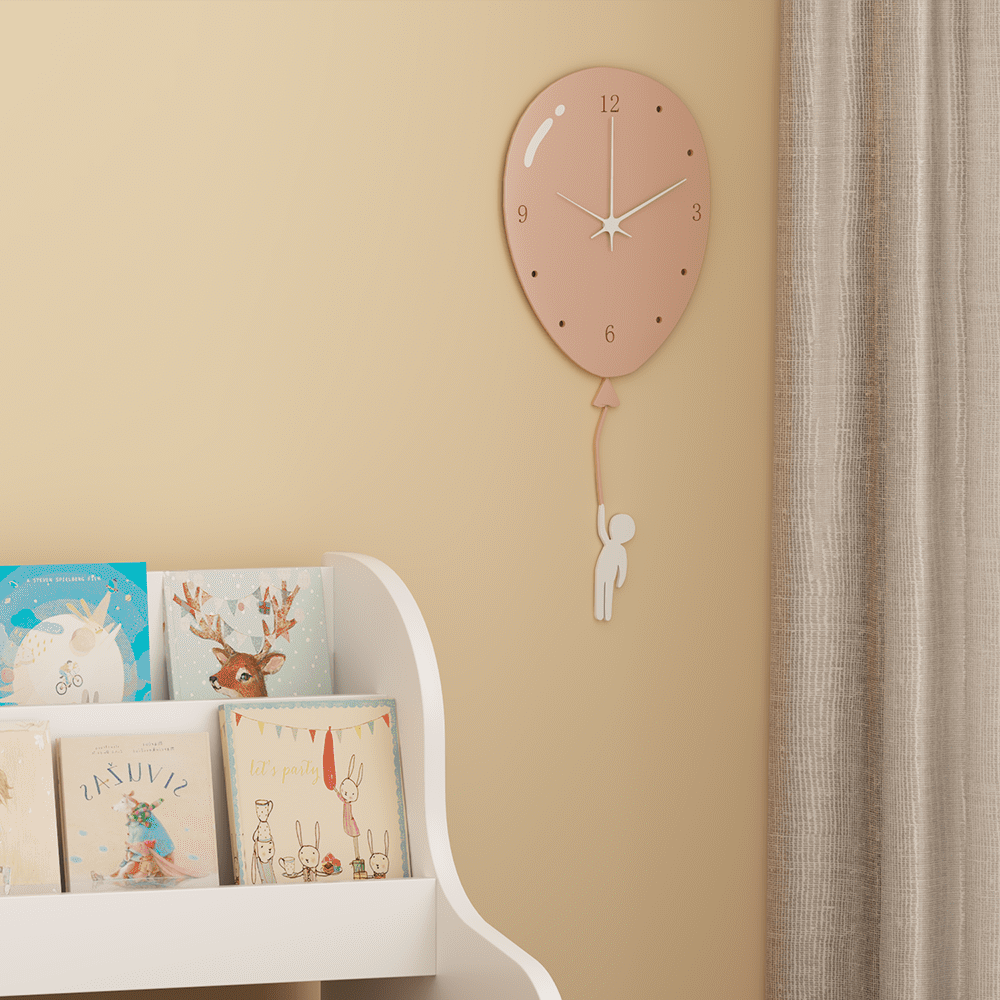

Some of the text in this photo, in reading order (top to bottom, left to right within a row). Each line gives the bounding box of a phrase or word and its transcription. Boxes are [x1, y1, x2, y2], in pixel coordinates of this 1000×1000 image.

[600, 94, 620, 113] 12
[517, 204, 528, 223] 9
[692, 203, 702, 222] 3
[604, 324, 615, 343] 6
[250, 759, 321, 785] let's party
